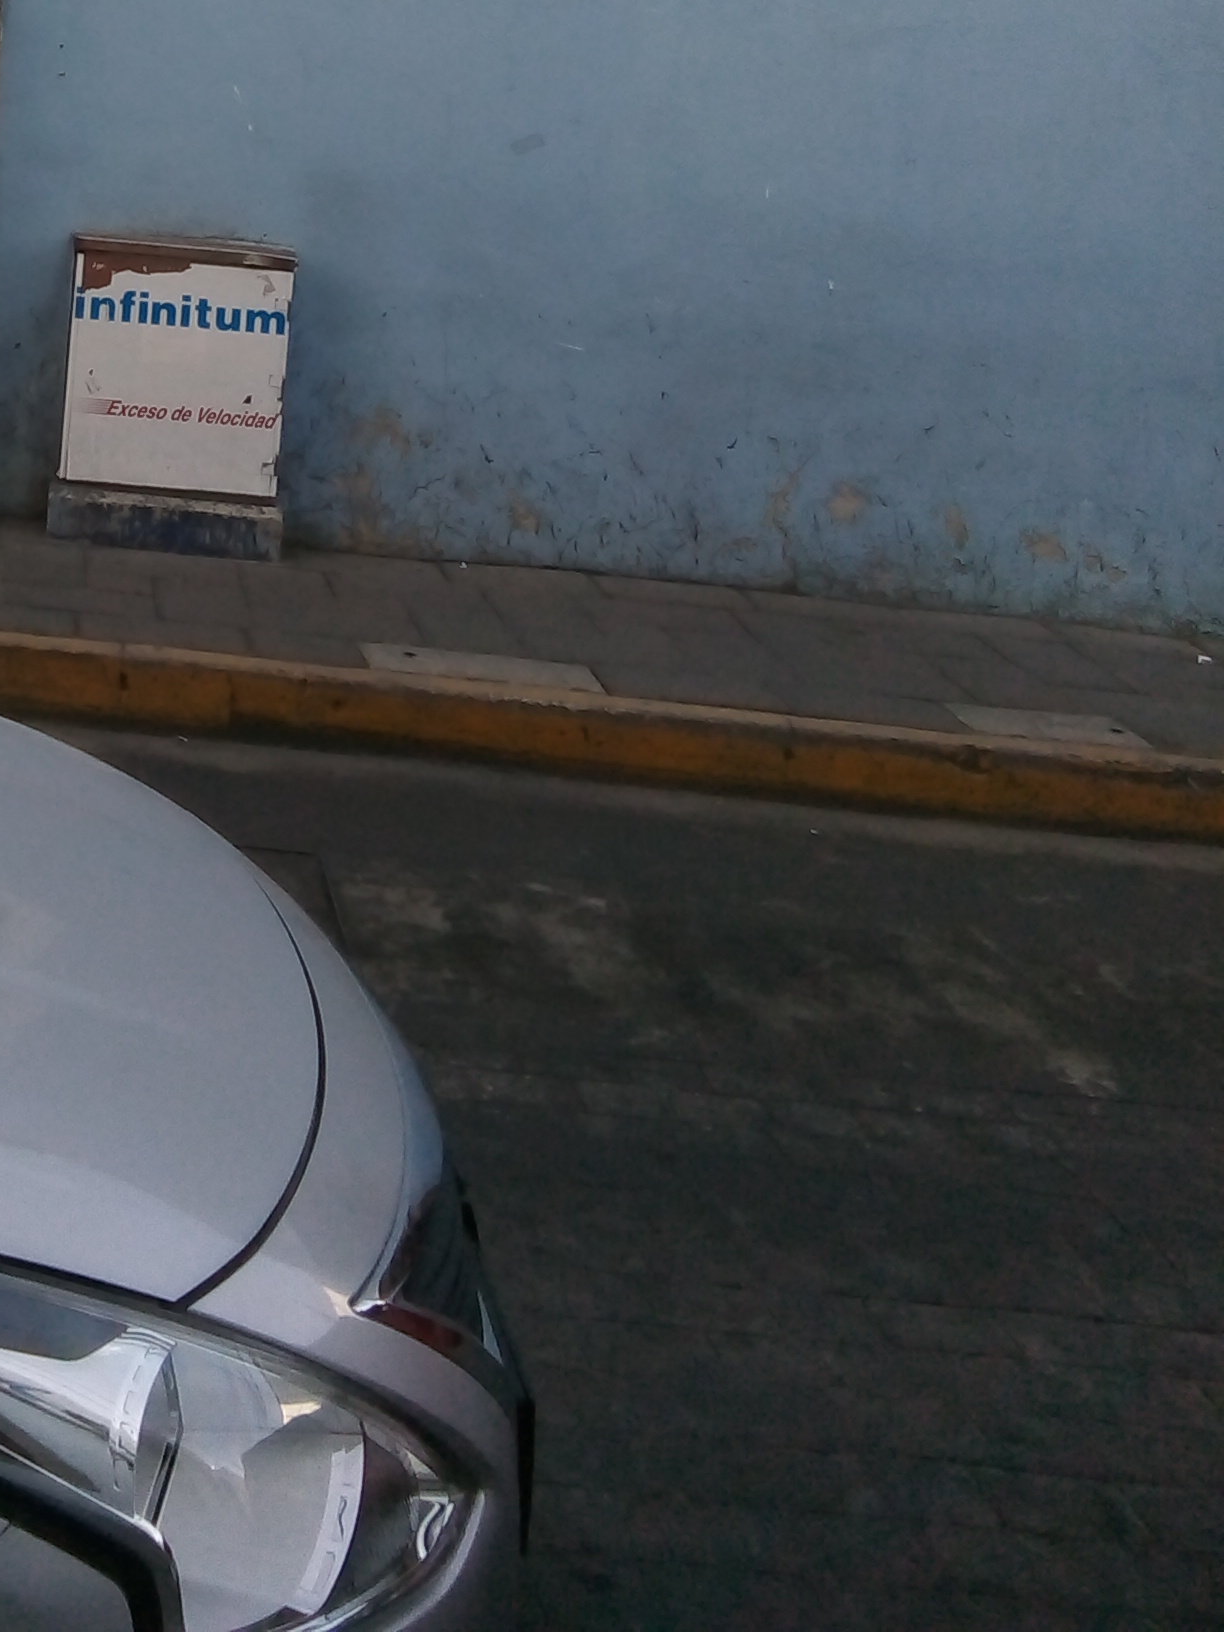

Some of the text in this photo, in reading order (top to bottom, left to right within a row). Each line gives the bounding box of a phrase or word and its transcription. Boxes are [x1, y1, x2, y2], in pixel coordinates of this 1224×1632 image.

[75, 287, 286, 336] infinitum
[107, 399, 280, 430] Exceso de Velocidad
